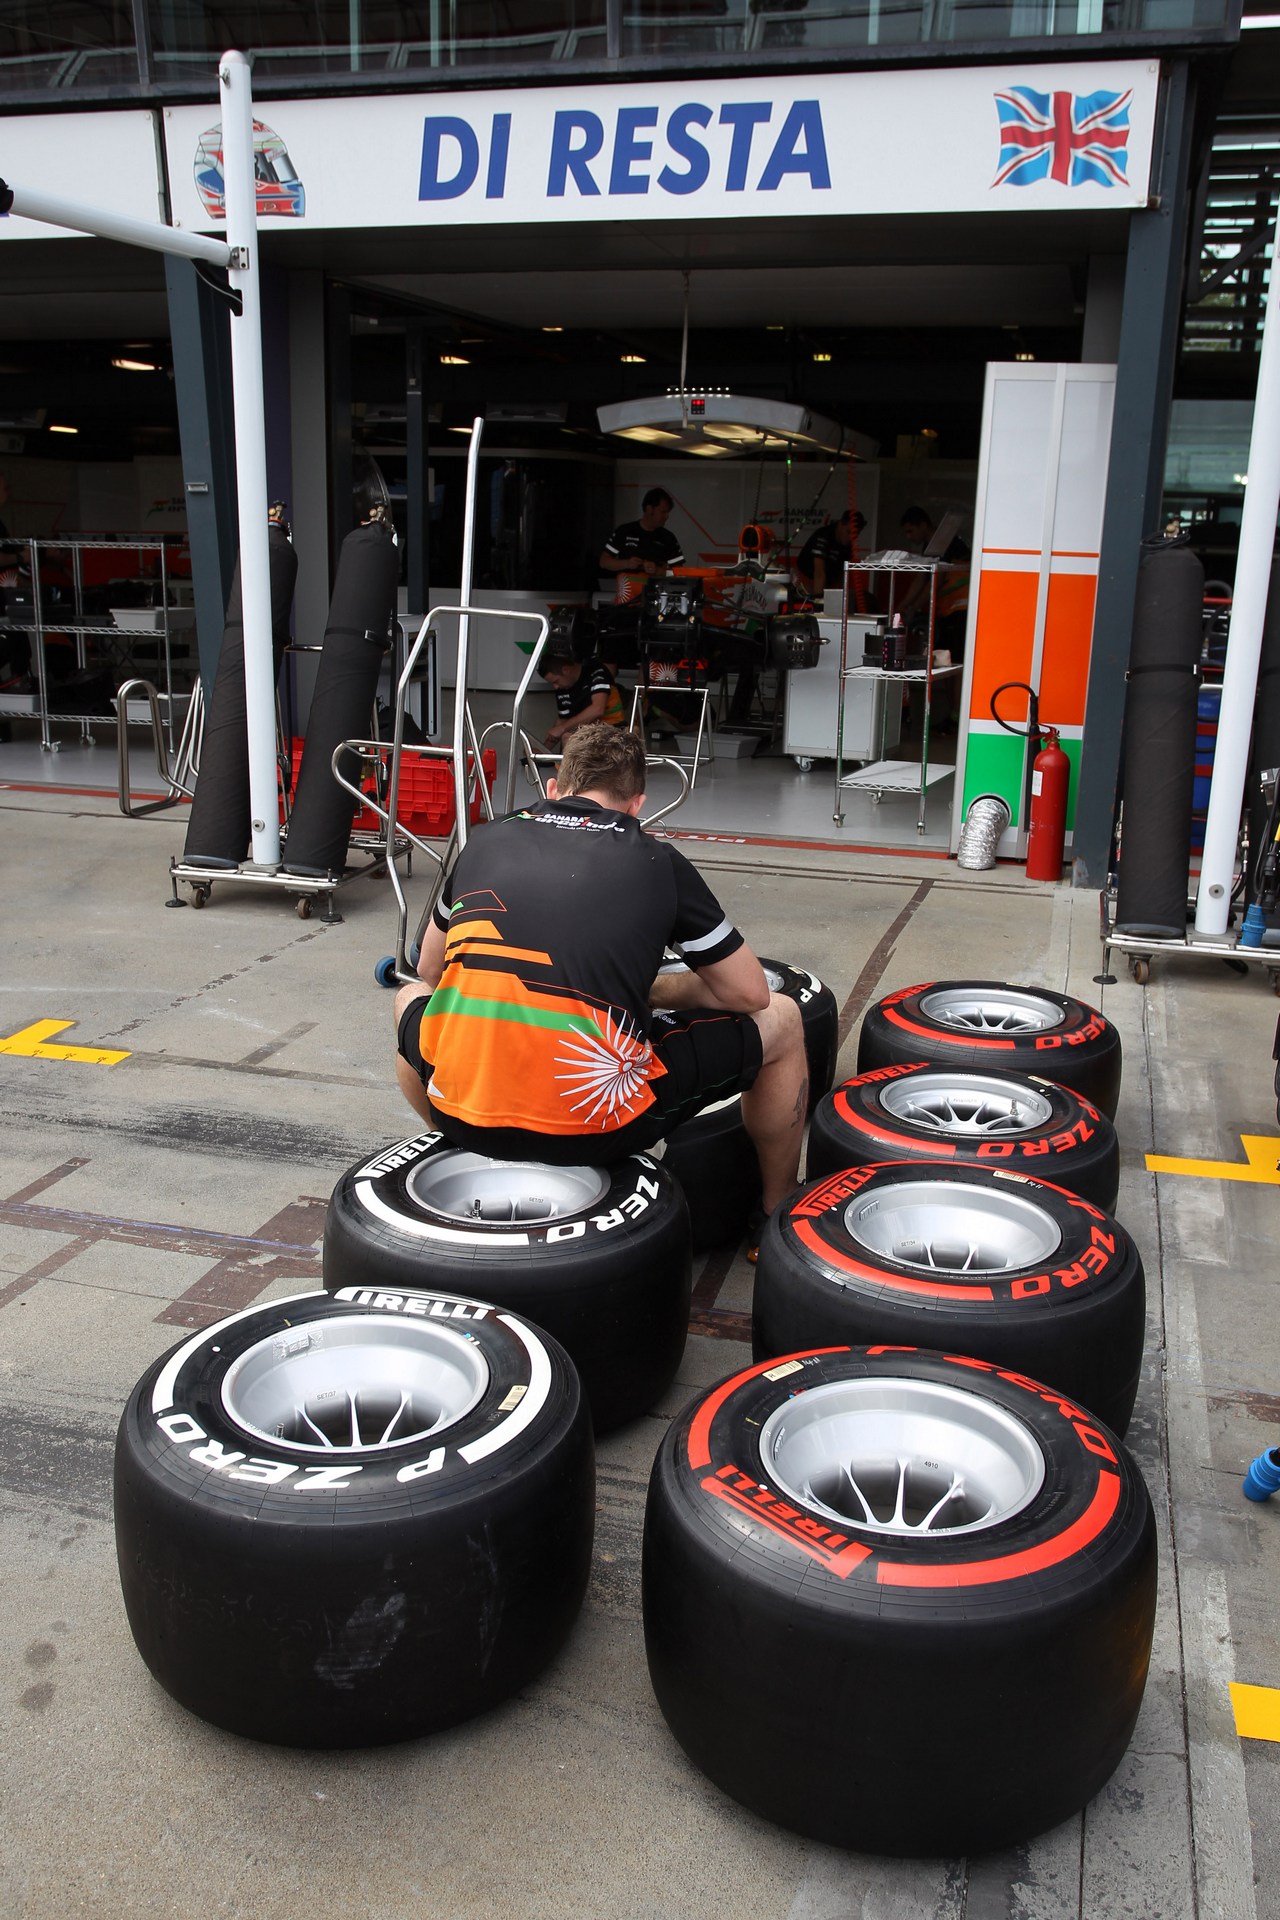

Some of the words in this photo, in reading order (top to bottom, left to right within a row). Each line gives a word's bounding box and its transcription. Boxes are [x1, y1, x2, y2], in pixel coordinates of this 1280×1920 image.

[418, 113, 512, 201] DI
[546, 100, 832, 197] RESTA
[800, 987, 813, 1004] P
[1036, 1013, 1107, 1050] ZERO
[841, 1062, 931, 1088] PIRELLI
[1077, 1101, 1101, 1122] P
[354, 1130, 445, 1179] PIRELLI
[976, 1119, 1095, 1158] ZERO
[546, 1174, 660, 1244] ZERO
[789, 1166, 878, 1217] PIRELLI
[1011, 1225, 1116, 1300] ZERO
[333, 1286, 496, 1320] PIRELLI
[943, 1355, 1119, 1464] ZERO
[156, 1413, 364, 1490] ZERO
[396, 1446, 446, 1483] P
[923, 1460, 939, 1470] 4910
[701, 1464, 874, 1580] PIRELLI
